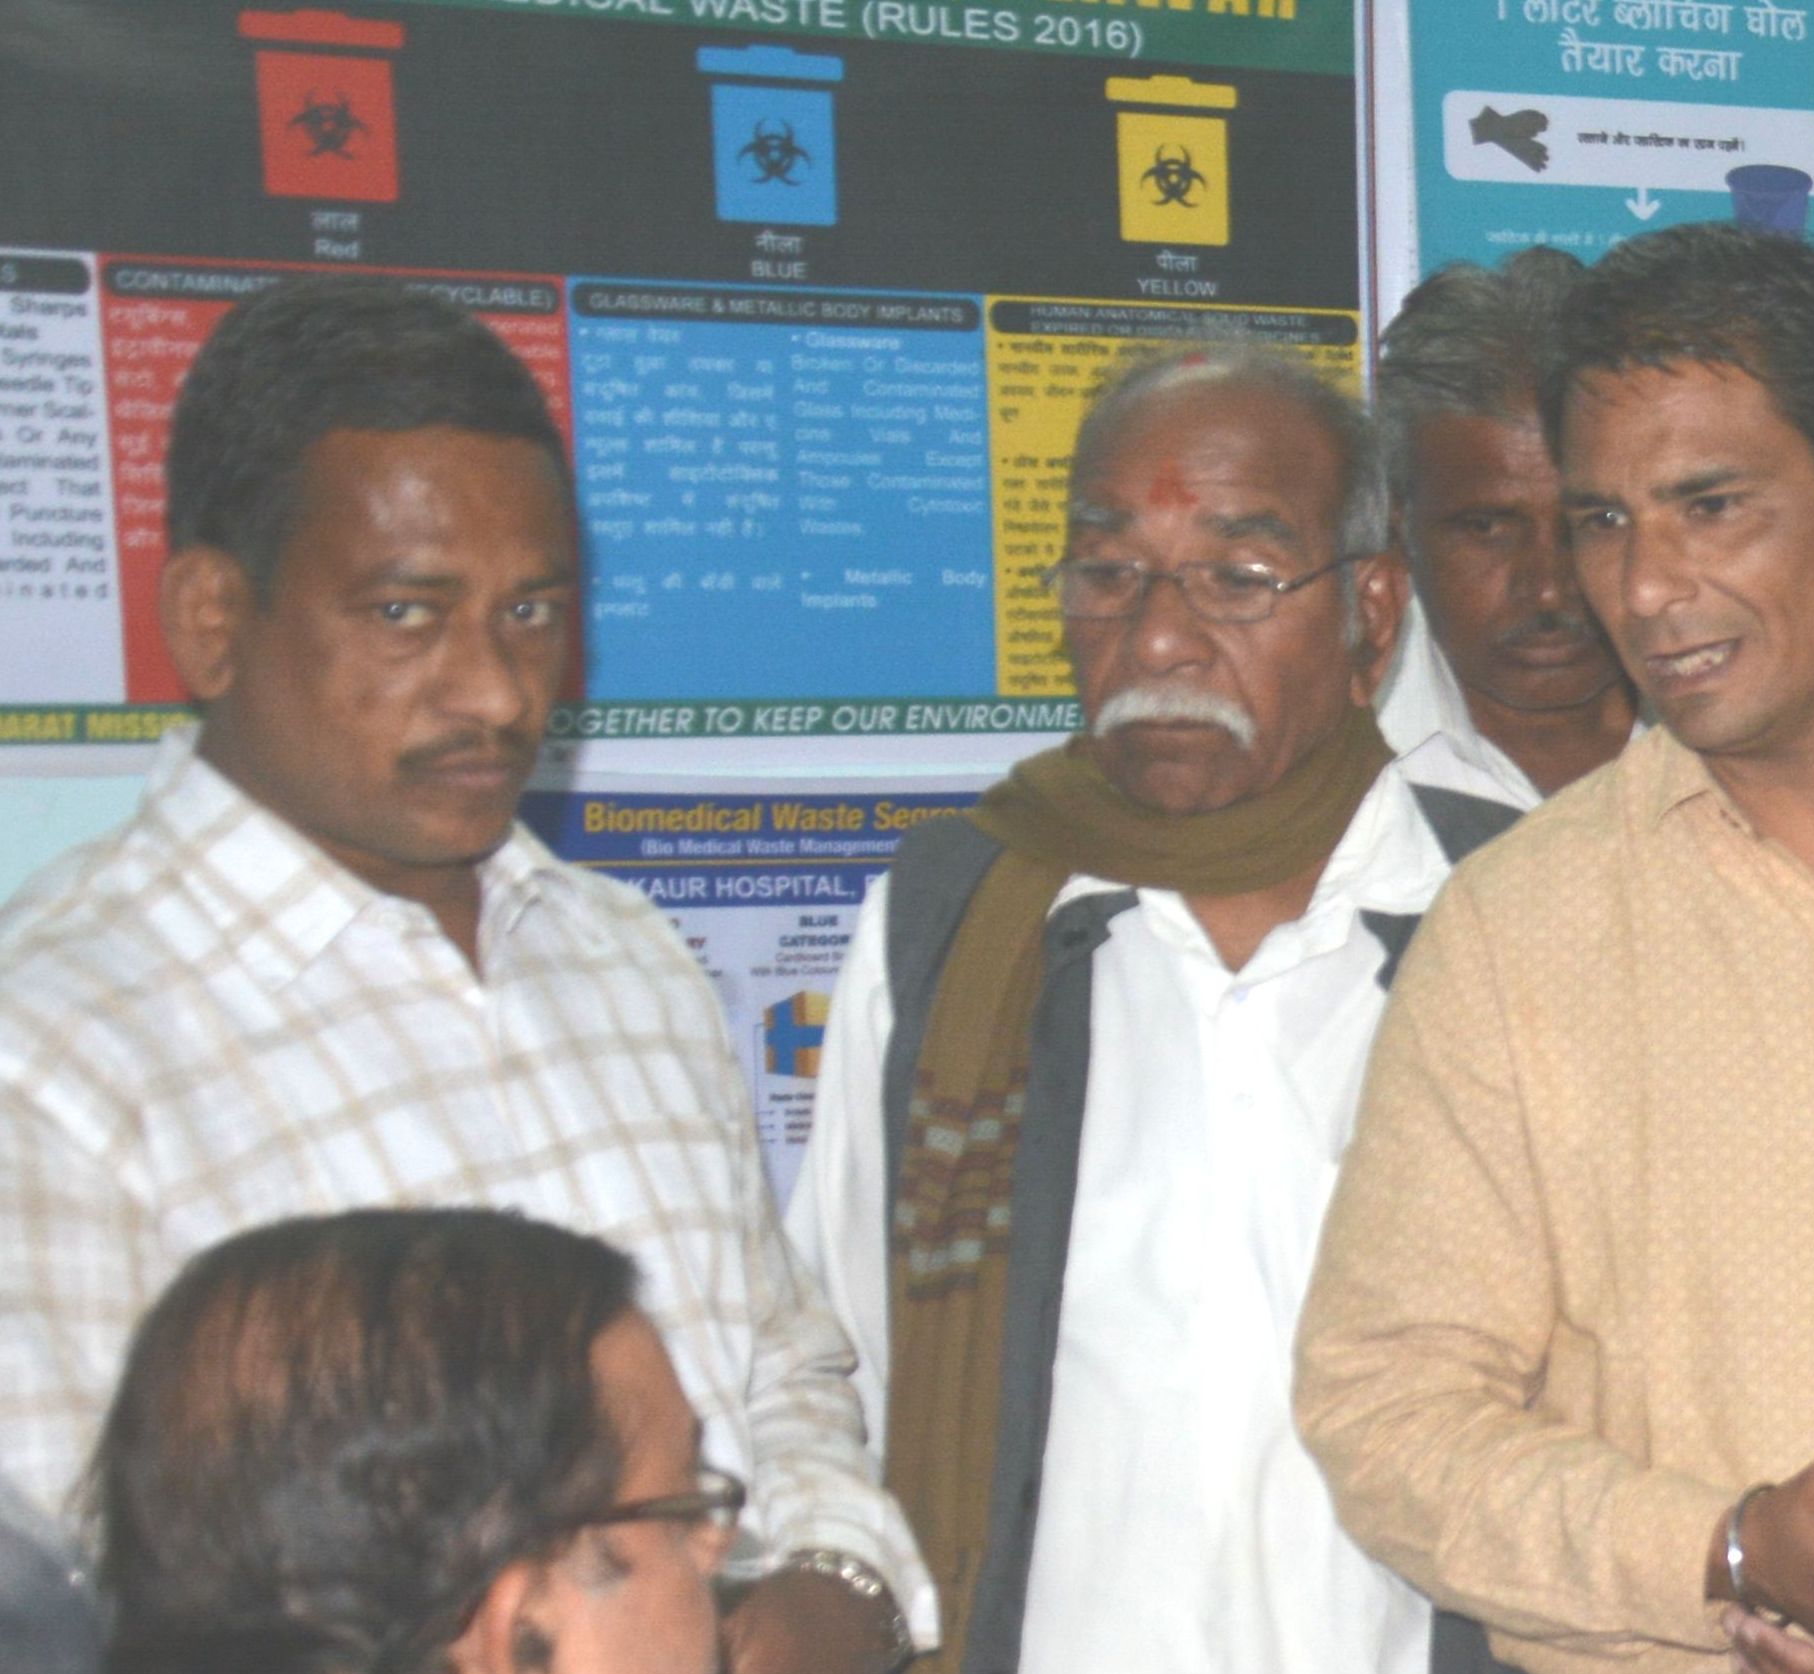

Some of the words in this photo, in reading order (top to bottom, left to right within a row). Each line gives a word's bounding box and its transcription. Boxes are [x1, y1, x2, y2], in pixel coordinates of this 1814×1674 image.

[862, 1, 1019, 41] (RULES
[1034, 15, 1143, 58] 2016)
[1557, 27, 1646, 77] तैयार
[1655, 45, 1743, 81] करना
[312, 212, 361, 231] लाल
[315, 240, 360, 259] Red
[755, 231, 802, 253] नीला
[115, 268, 283, 294] CONTAMINAT
[751, 261, 807, 280] BLUE
[1137, 278, 1218, 297] YELLOW
[588, 292, 706, 314] GLASSWARE
[733, 297, 816, 318] METALLIC
[821, 300, 870, 320] BODY
[876, 301, 964, 324] IMPLANTS
[16, 425, 42, 443] Or
[940, 569, 987, 589] Body
[0, 711, 76, 740] ARAT
[549, 705, 695, 735] OGETHER
[703, 705, 743, 732] TO
[753, 705, 822, 732] KEEP
[833, 704, 896, 731] OUR
[905, 702, 1085, 731] ENVIRONME
[584, 802, 762, 833] Biomedical
[772, 801, 864, 831] Waste
[641, 838, 674, 858] (Bio
[679, 837, 742, 856] Medical
[747, 837, 796, 855] Waste
[715, 874, 856, 899] HOSPITAL,
[798, 915, 838, 928] BLUE
[778, 934, 852, 948] CATEGOR
